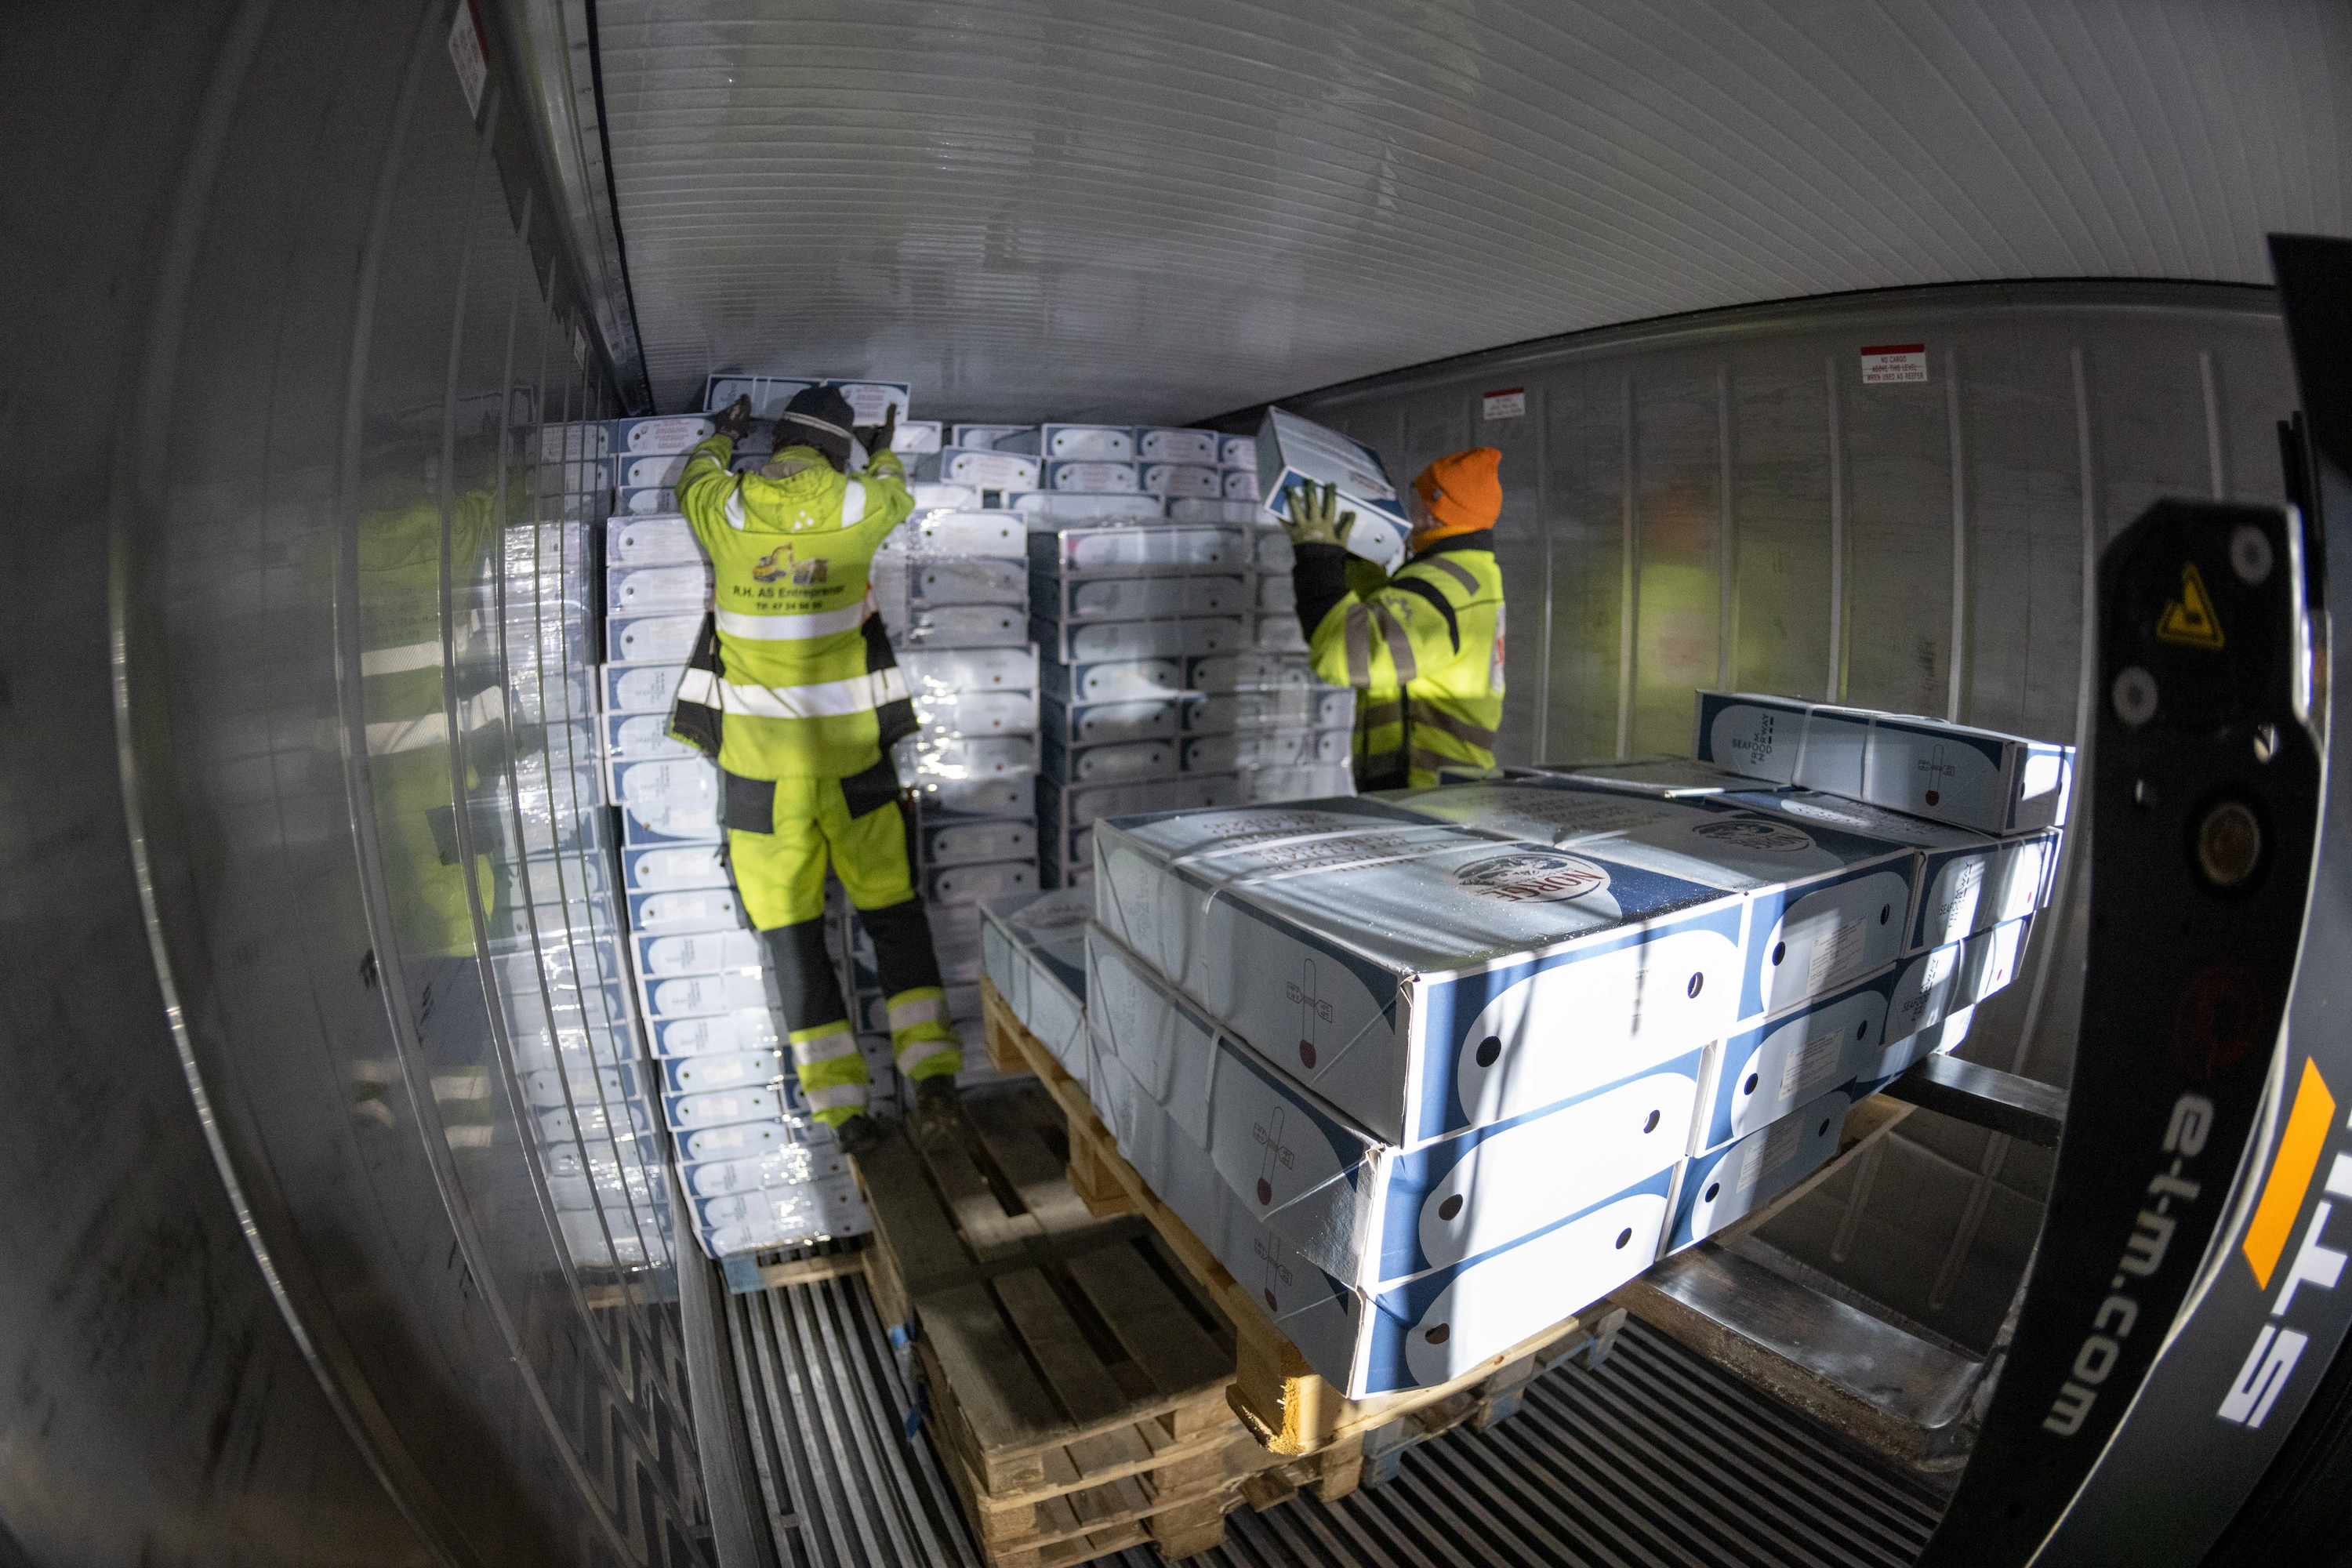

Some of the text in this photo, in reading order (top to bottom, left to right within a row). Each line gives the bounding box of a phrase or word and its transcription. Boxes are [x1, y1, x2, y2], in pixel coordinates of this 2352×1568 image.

[1732, 738, 1772, 753] SEAFOOD
[1759, 713, 1769, 762] NORWAY
[1480, 869, 1606, 902] NORGE
[2217, 1108, 2352, 1428] ST
